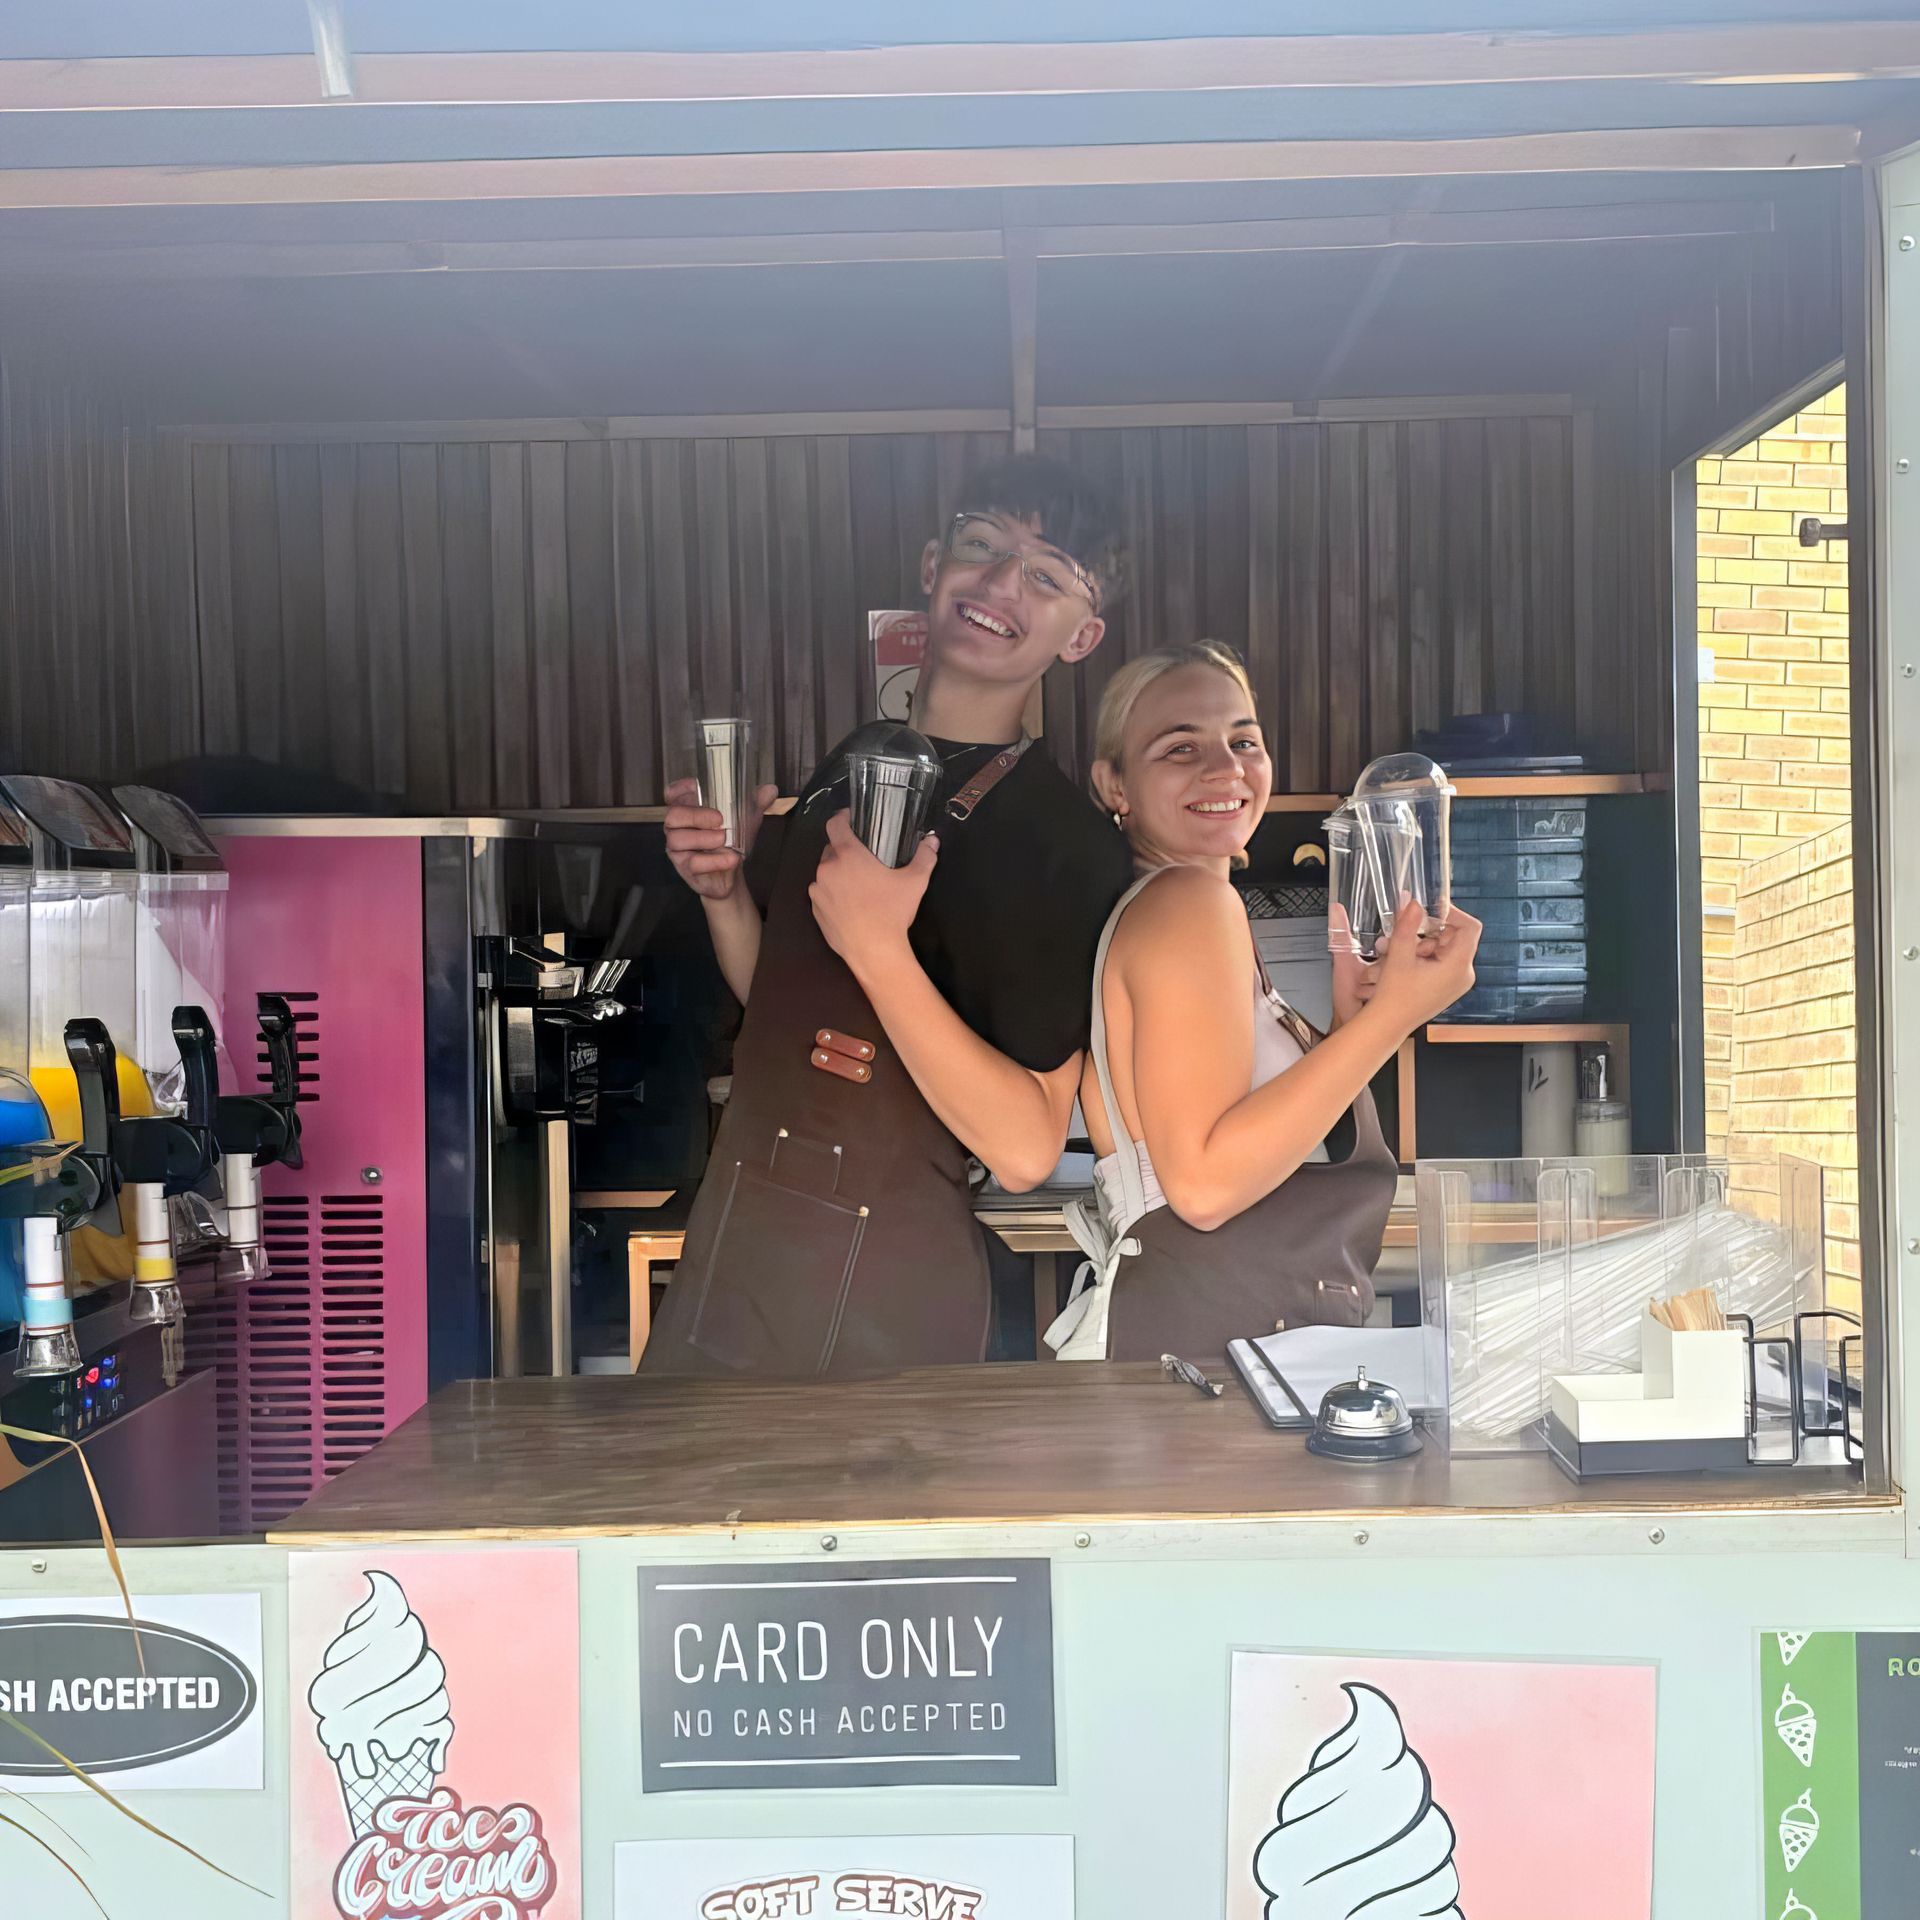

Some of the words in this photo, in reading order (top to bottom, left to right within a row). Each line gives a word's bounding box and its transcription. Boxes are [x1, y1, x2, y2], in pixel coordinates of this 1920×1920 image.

[673, 1620, 829, 1684] CARD
[860, 1615, 1003, 1680] ONLY
[47, 1676, 220, 1712] ACCEPTED
[673, 1709, 713, 1738] NO
[733, 1708, 816, 1736] CASH
[837, 1702, 1007, 1734] ACCEPTED
[338, 1835, 547, 1917] Cream
[702, 1875, 820, 1920] SOFT
[834, 1874, 982, 1920] SERVE
